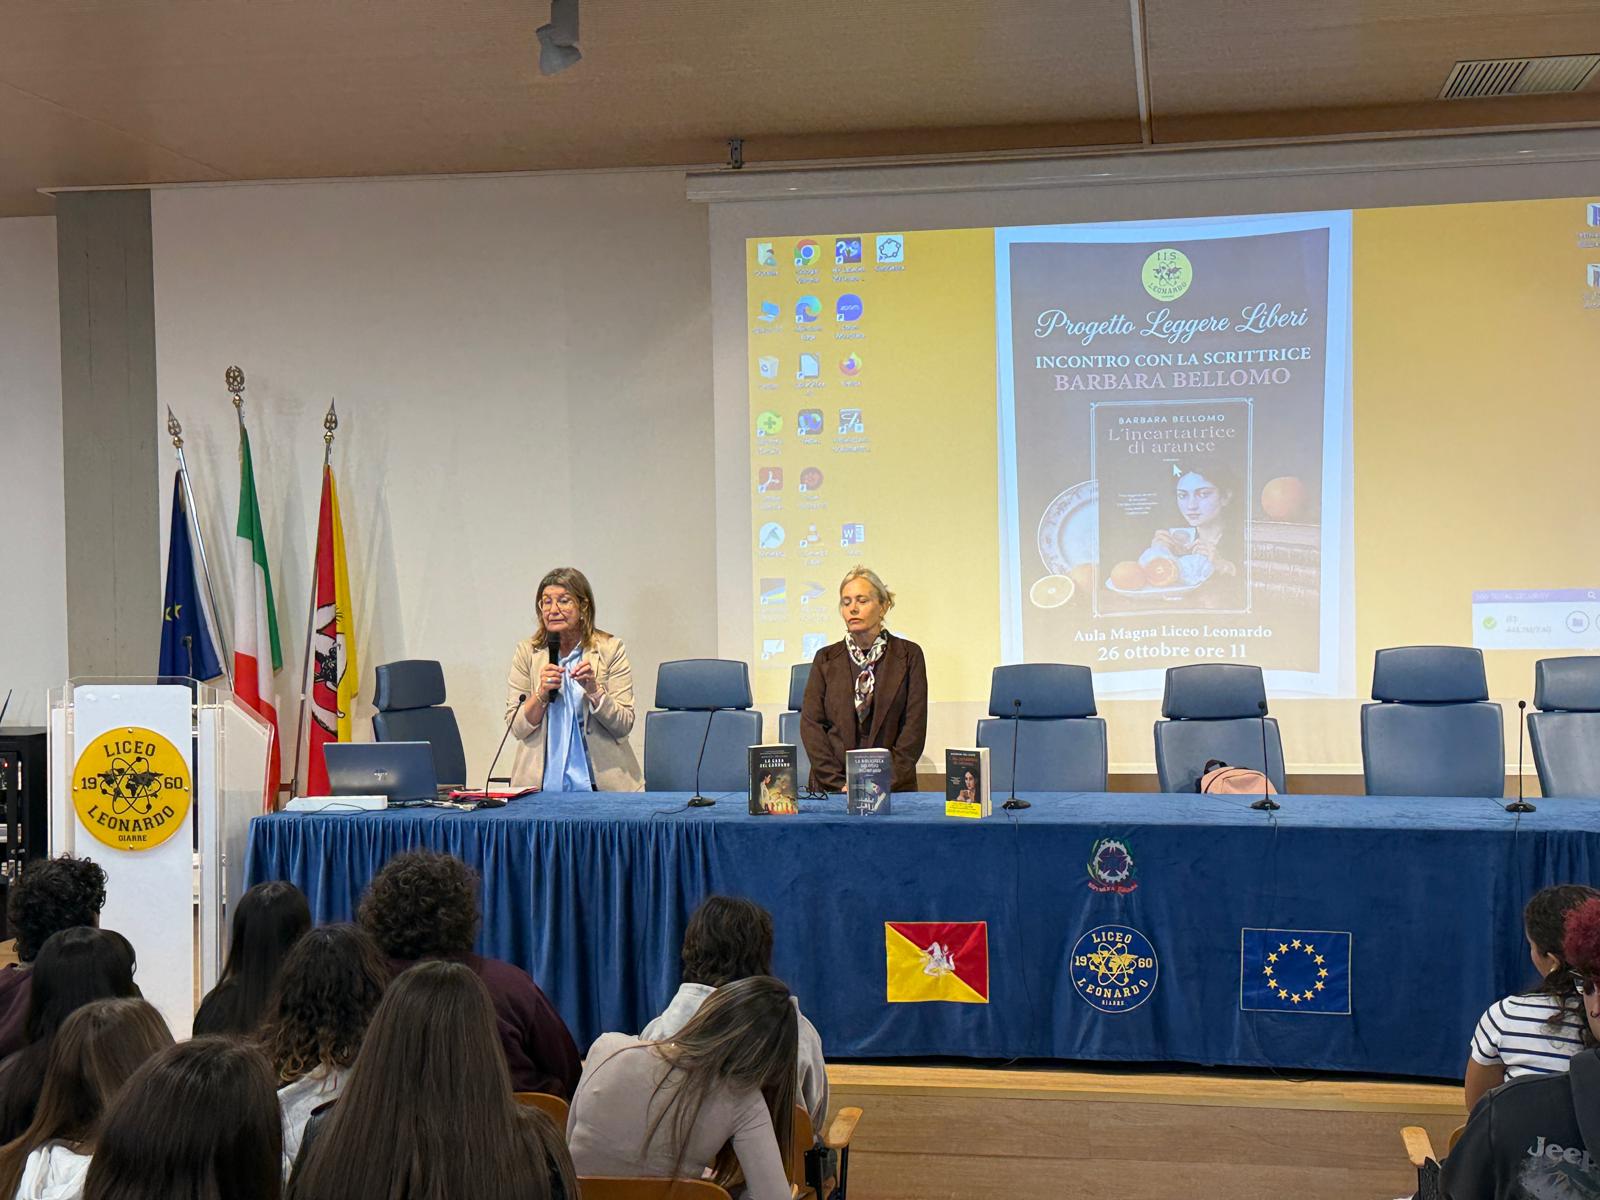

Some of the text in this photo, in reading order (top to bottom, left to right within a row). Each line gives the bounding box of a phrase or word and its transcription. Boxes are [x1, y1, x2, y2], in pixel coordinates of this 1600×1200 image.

[1034, 302, 1309, 346] Progetto Leggere Liberi
[1035, 347, 1311, 369] INCONTRO CON LA SCRITTRICE
[1054, 368, 1291, 392] BARBARA BELLOMO
[1118, 414, 1225, 425] BARBARA BELLOMO
[1108, 426, 1236, 441] L'incartatrice
[1128, 441, 1216, 454] di arance
[1073, 625, 1272, 642] Aula Magna Liceo Leonardo
[1097, 643, 1247, 661] 26 ottobre ore 11
[103, 740, 156, 757] LICEO
[81, 777, 183, 789] 19 60
[87, 805, 175, 832] LEONARDO
[1091, 931, 1133, 944] LICEO
[1074, 955, 1153, 968] 19 60
[1076, 977, 1149, 998] LEONARDO
